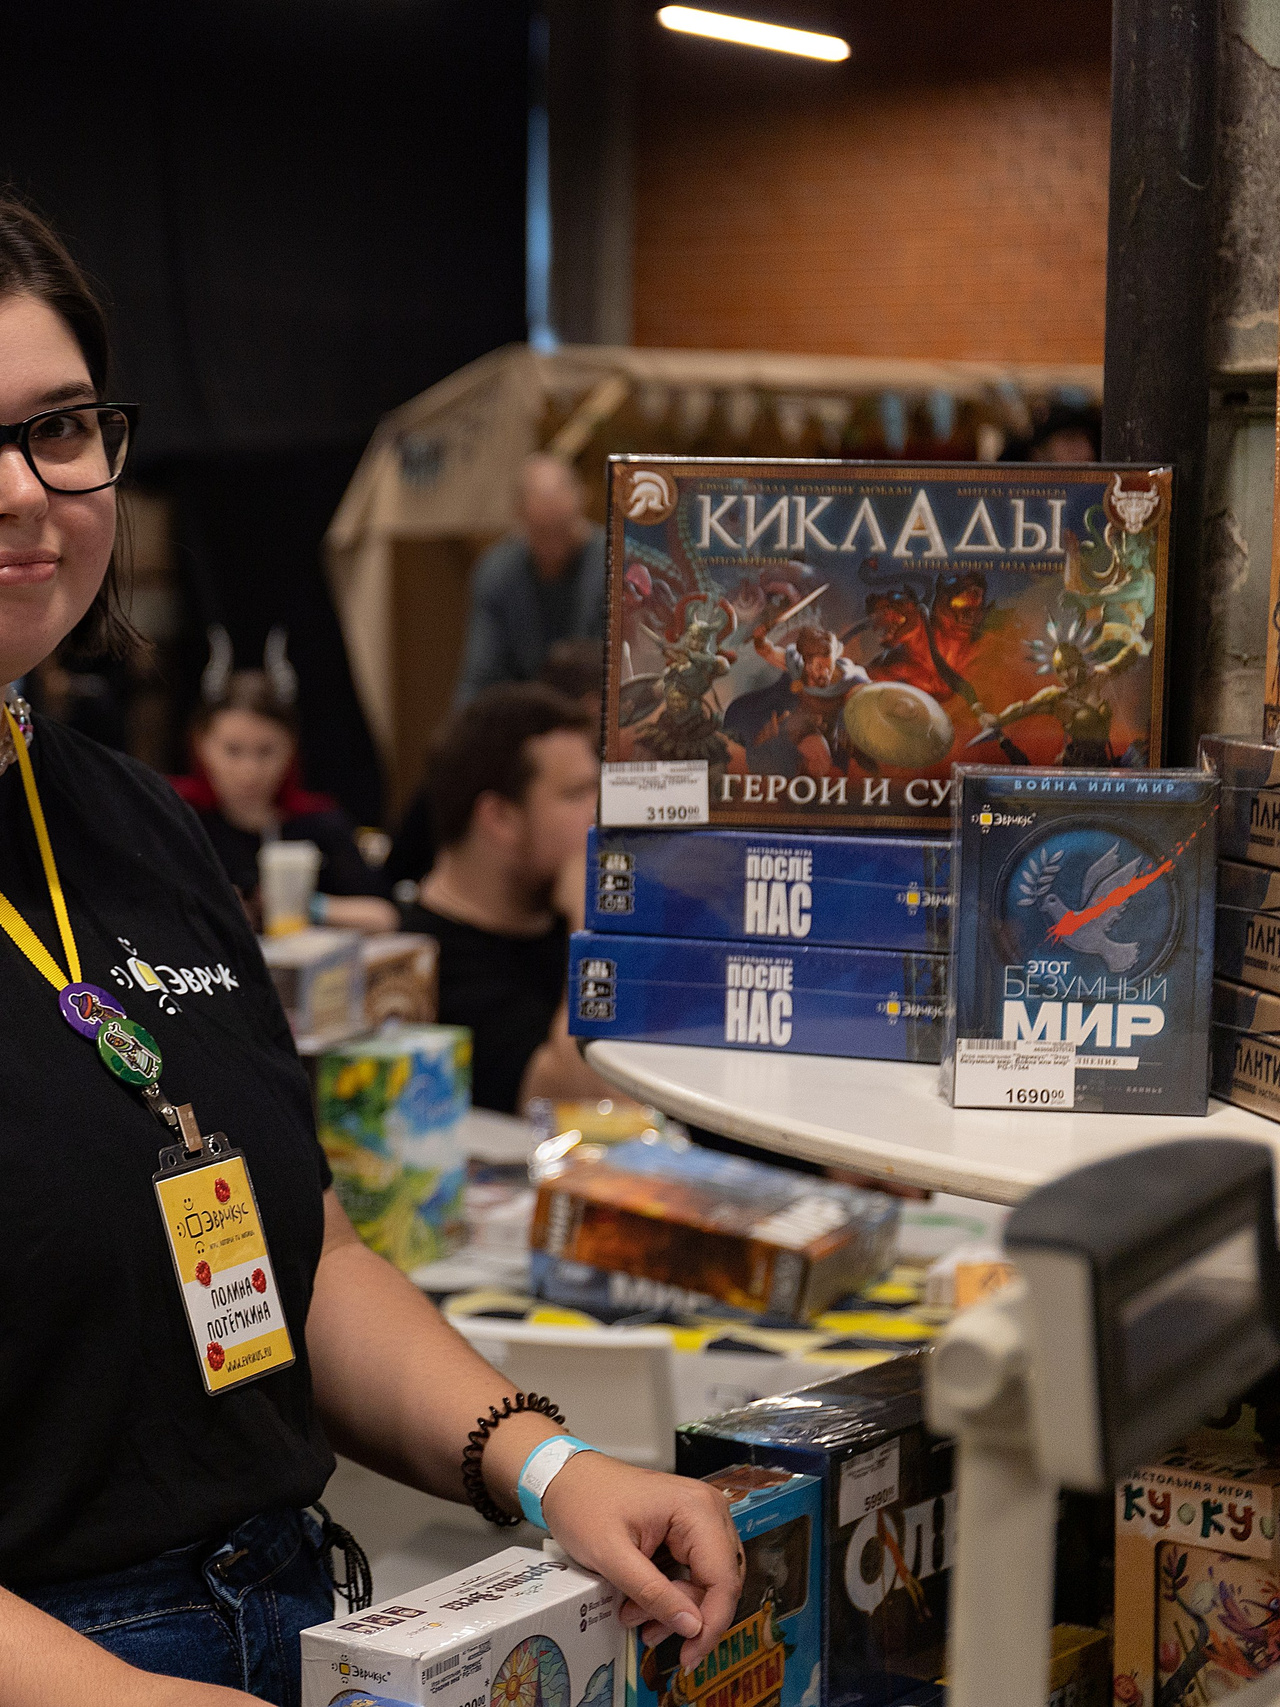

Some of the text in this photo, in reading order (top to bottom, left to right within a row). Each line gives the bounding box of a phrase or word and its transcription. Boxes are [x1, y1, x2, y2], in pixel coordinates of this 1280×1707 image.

[696, 488, 1066, 559] КИКЛАДЫ
[720, 774, 849, 805] ГЕРОИ
[862, 777, 892, 807] И
[1014, 776, 1176, 794] ВОЙНА ИЛИ МИР
[746, 854, 813, 883] ПОСЛЕ
[744, 881, 813, 938] НАС
[726, 963, 794, 991] ПОСЛЕ
[1003, 965, 1168, 1002] БЕЗУМНЫЙ
[1027, 960, 1071, 975] ЭТОТ
[725, 988, 794, 1047] НАС
[1002, 1000, 1166, 1049] МИР
[200, 1201, 250, 1233] Эврикус
[210, 1276, 253, 1310] ПОЛИНА
[206, 1300, 272, 1342] ПОТЁМКИНА
[1123, 1471, 1213, 1494] АСТОЛЬНАЯ
[351, 1664, 389, 1684] Эврикус
